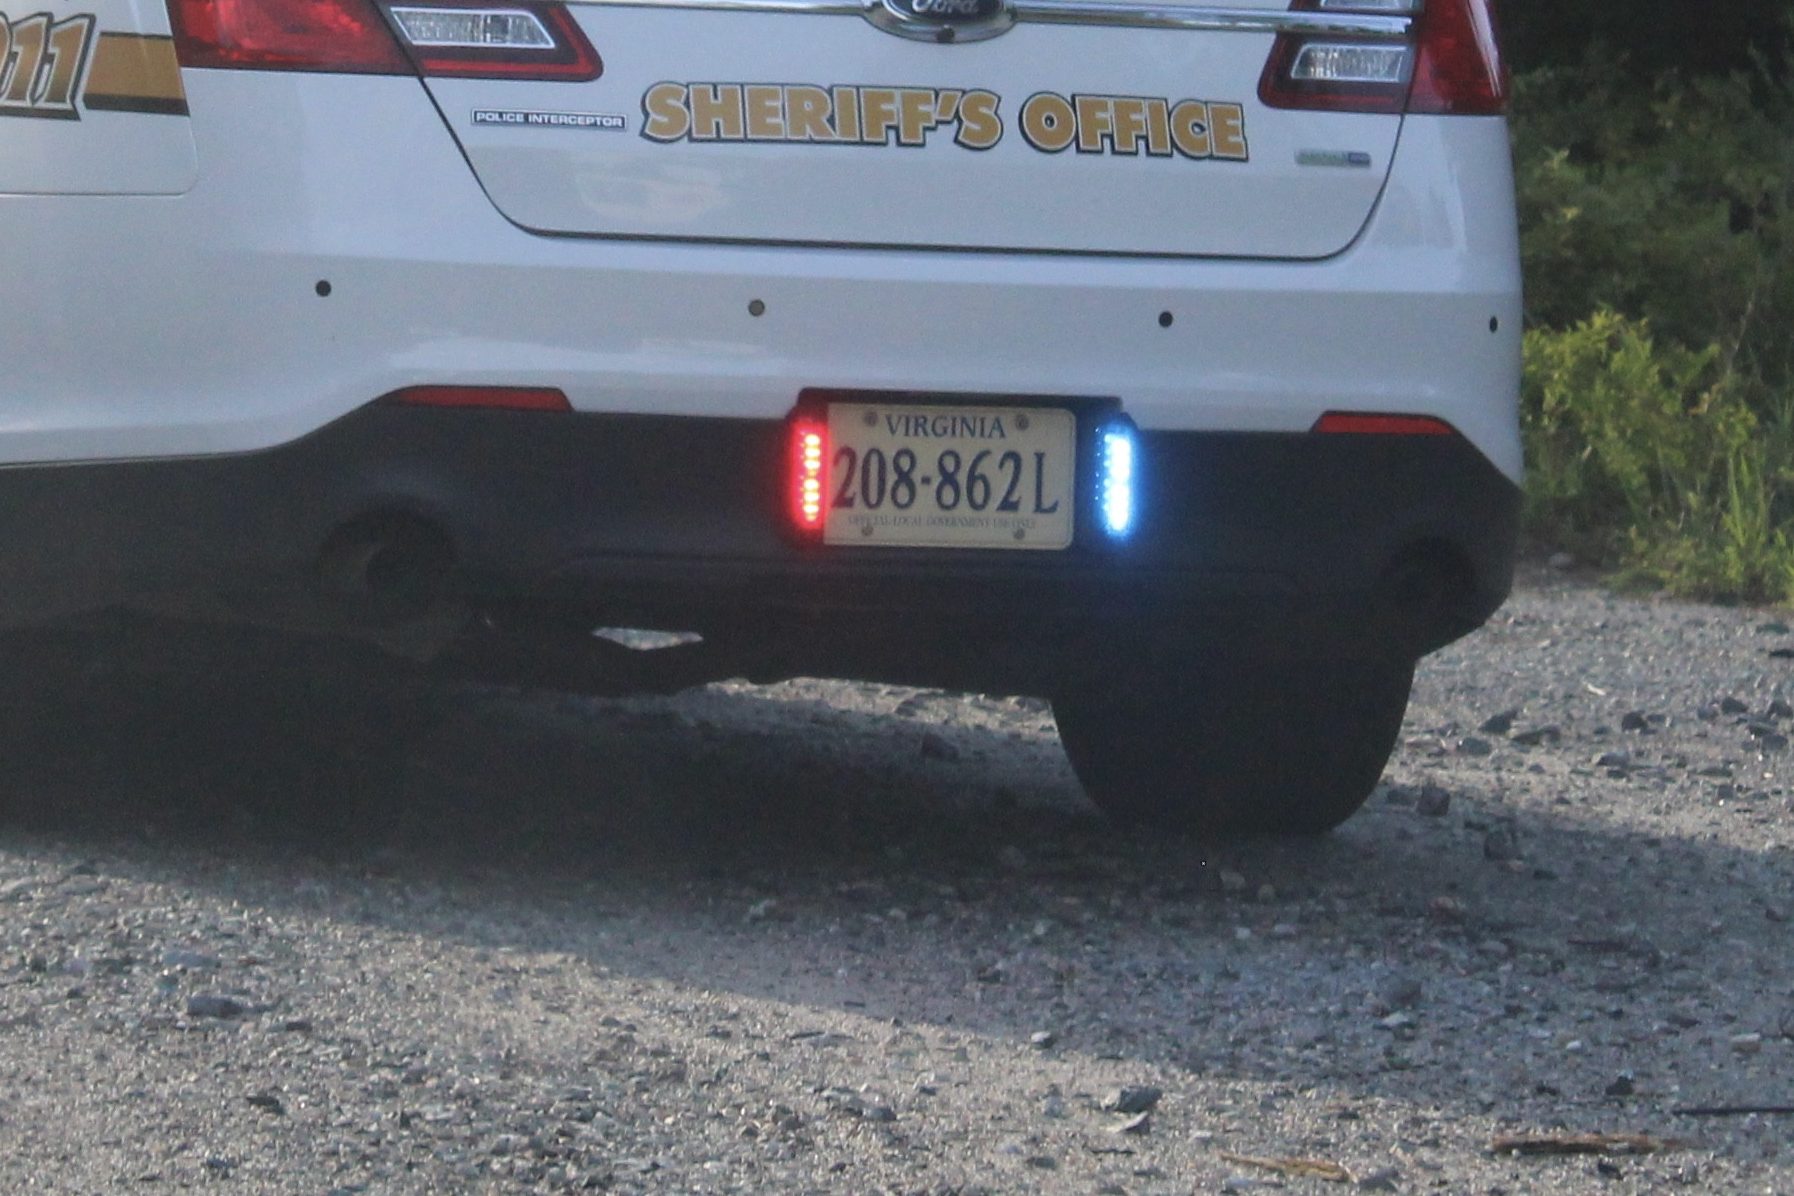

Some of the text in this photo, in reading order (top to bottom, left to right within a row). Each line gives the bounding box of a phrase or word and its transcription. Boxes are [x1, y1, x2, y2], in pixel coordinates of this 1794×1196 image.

[475, 111, 623, 127] POLICE INTERCEPTOR
[640, 80, 1249, 163] SHERIFF'S OFFICE
[885, 414, 1007, 439] VIRGINIA
[831, 446, 1059, 514] 208-862L
